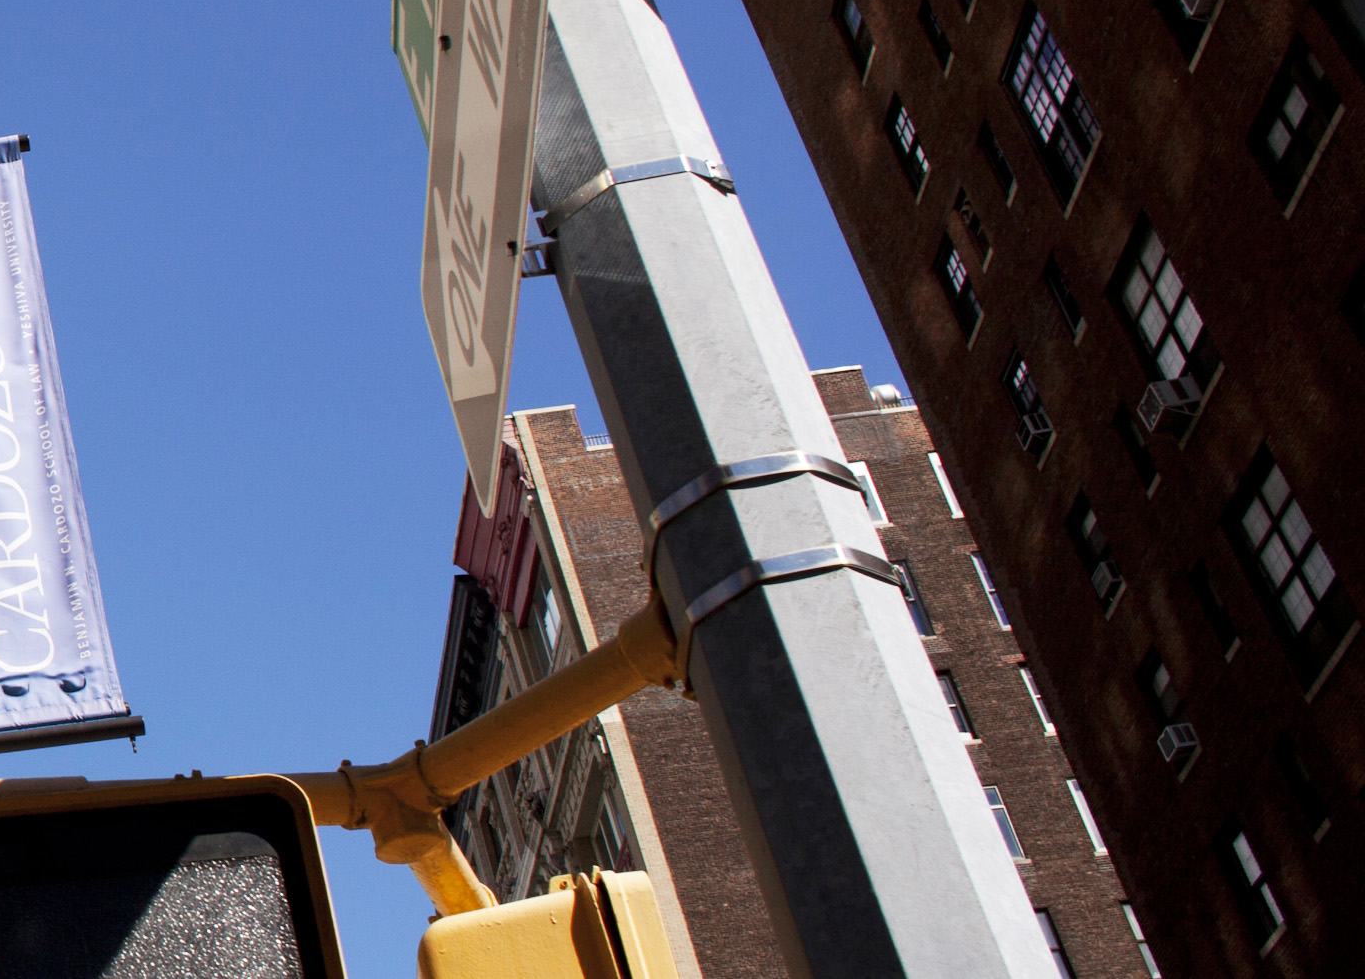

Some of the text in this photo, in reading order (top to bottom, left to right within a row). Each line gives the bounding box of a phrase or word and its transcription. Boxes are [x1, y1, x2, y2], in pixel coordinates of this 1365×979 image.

[0, 200, 21, 277] UNIVERSITY
[448, 149, 487, 368] ONE
[14, 280, 33, 340] YESHIVA
[28, 363, 43, 393] LAW
[34, 399, 47, 415] OF
[38, 421, 58, 478] SCHOOL
[49, 483, 72, 554] CARDOZO
[67, 580, 91, 659] BENJAMIN
